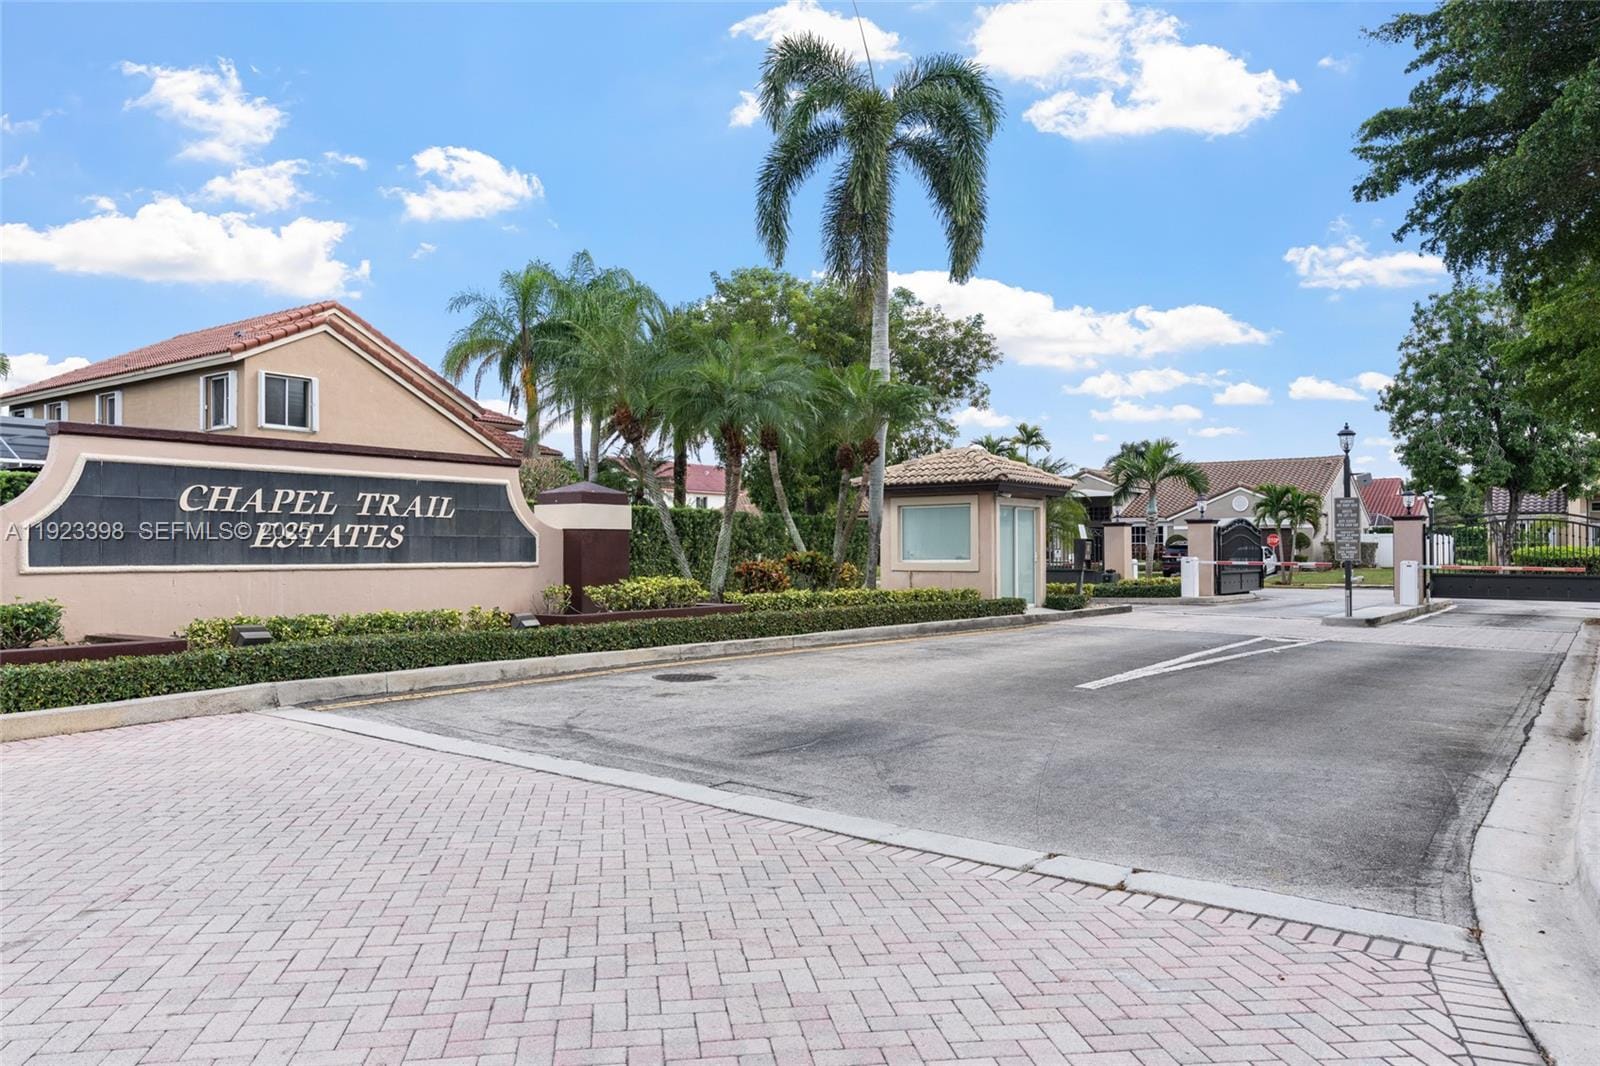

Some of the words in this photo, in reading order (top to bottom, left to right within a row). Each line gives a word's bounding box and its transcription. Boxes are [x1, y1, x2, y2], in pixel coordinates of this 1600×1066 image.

[178, 484, 338, 515] CHAPEL
[355, 491, 456, 519] TRAIL
[250, 522, 406, 549] ESTATES
